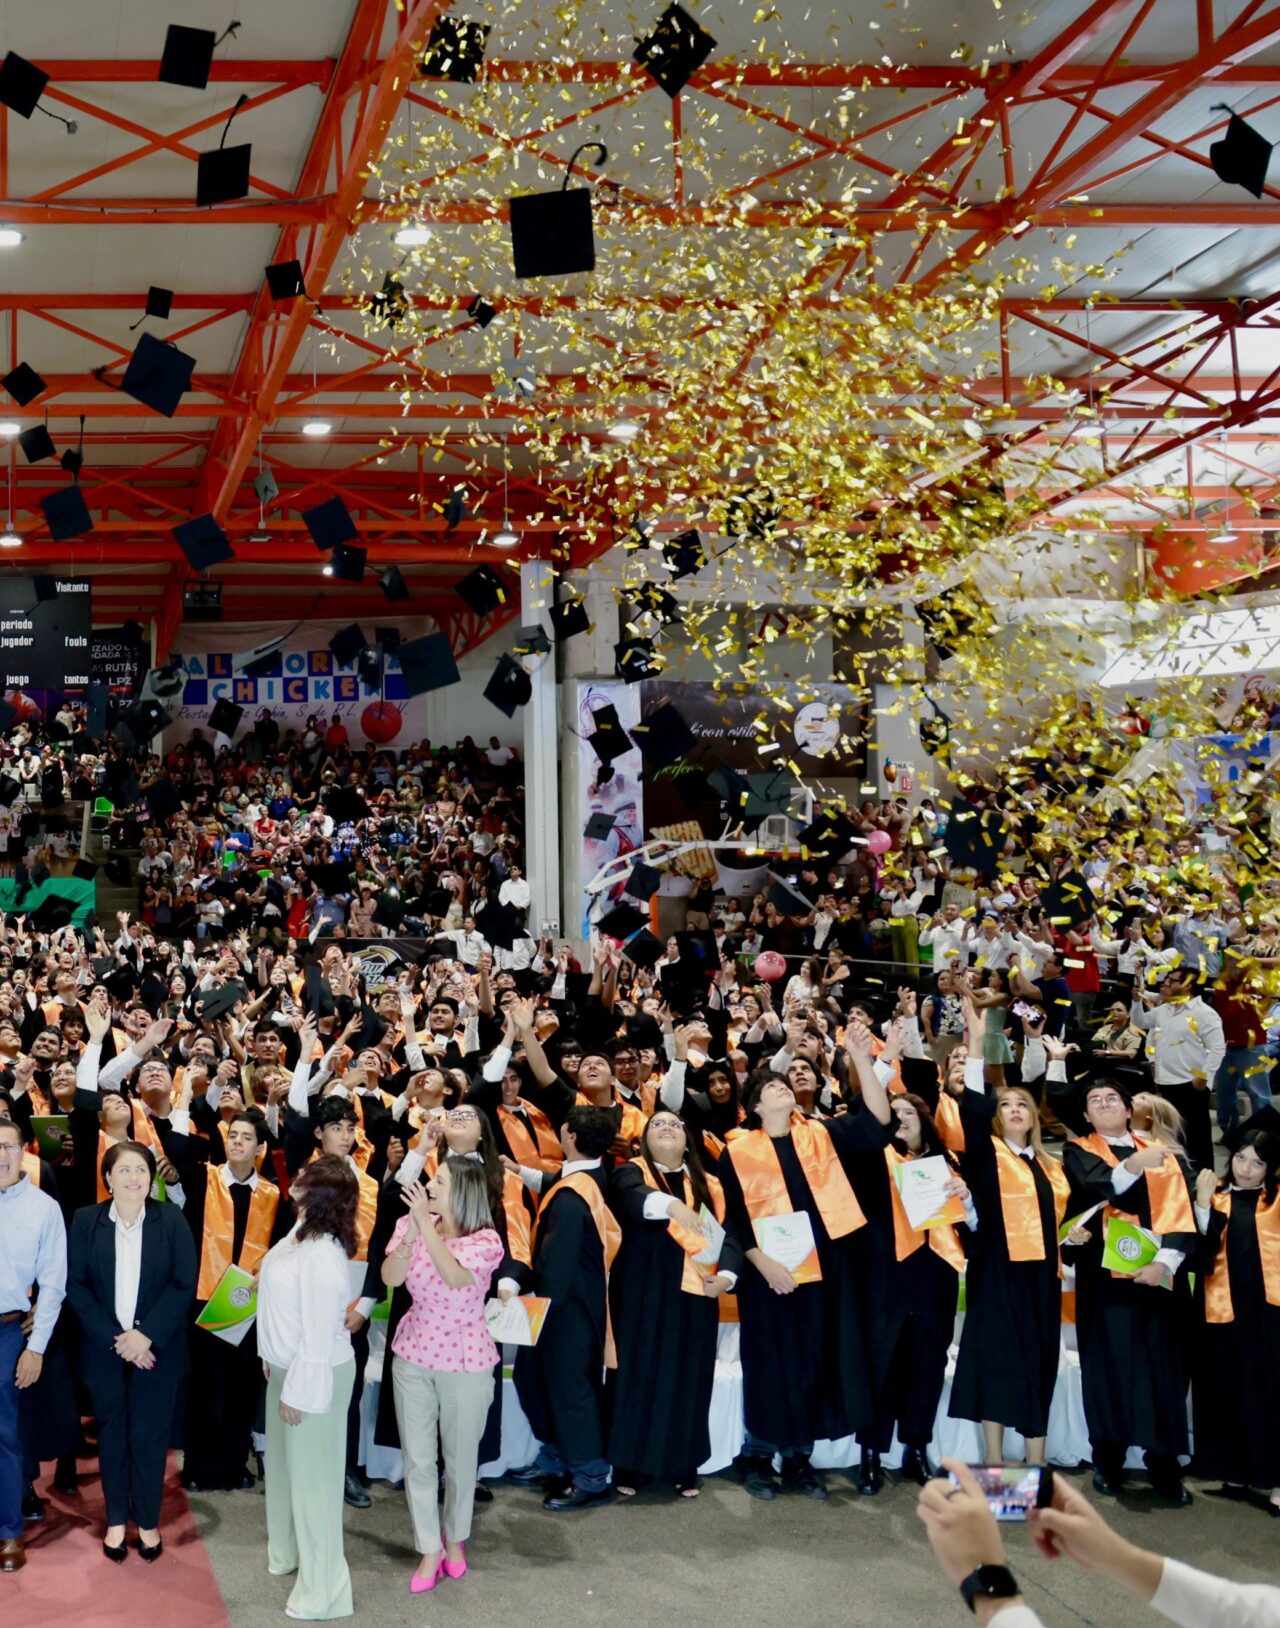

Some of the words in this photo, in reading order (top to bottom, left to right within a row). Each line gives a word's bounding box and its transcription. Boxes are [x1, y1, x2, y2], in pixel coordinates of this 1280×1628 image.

[55, 581, 89, 593] Visitante
[1, 619, 33, 631] periodo
[0, 636, 34, 648] jugador
[65, 635, 88, 647] fouls
[105, 663, 138, 673] RUTAS
[6, 674, 30, 686] juego
[64, 674, 89, 685] tantos
[109, 677, 132, 686] LPZ
[701, 728, 724, 737] con
